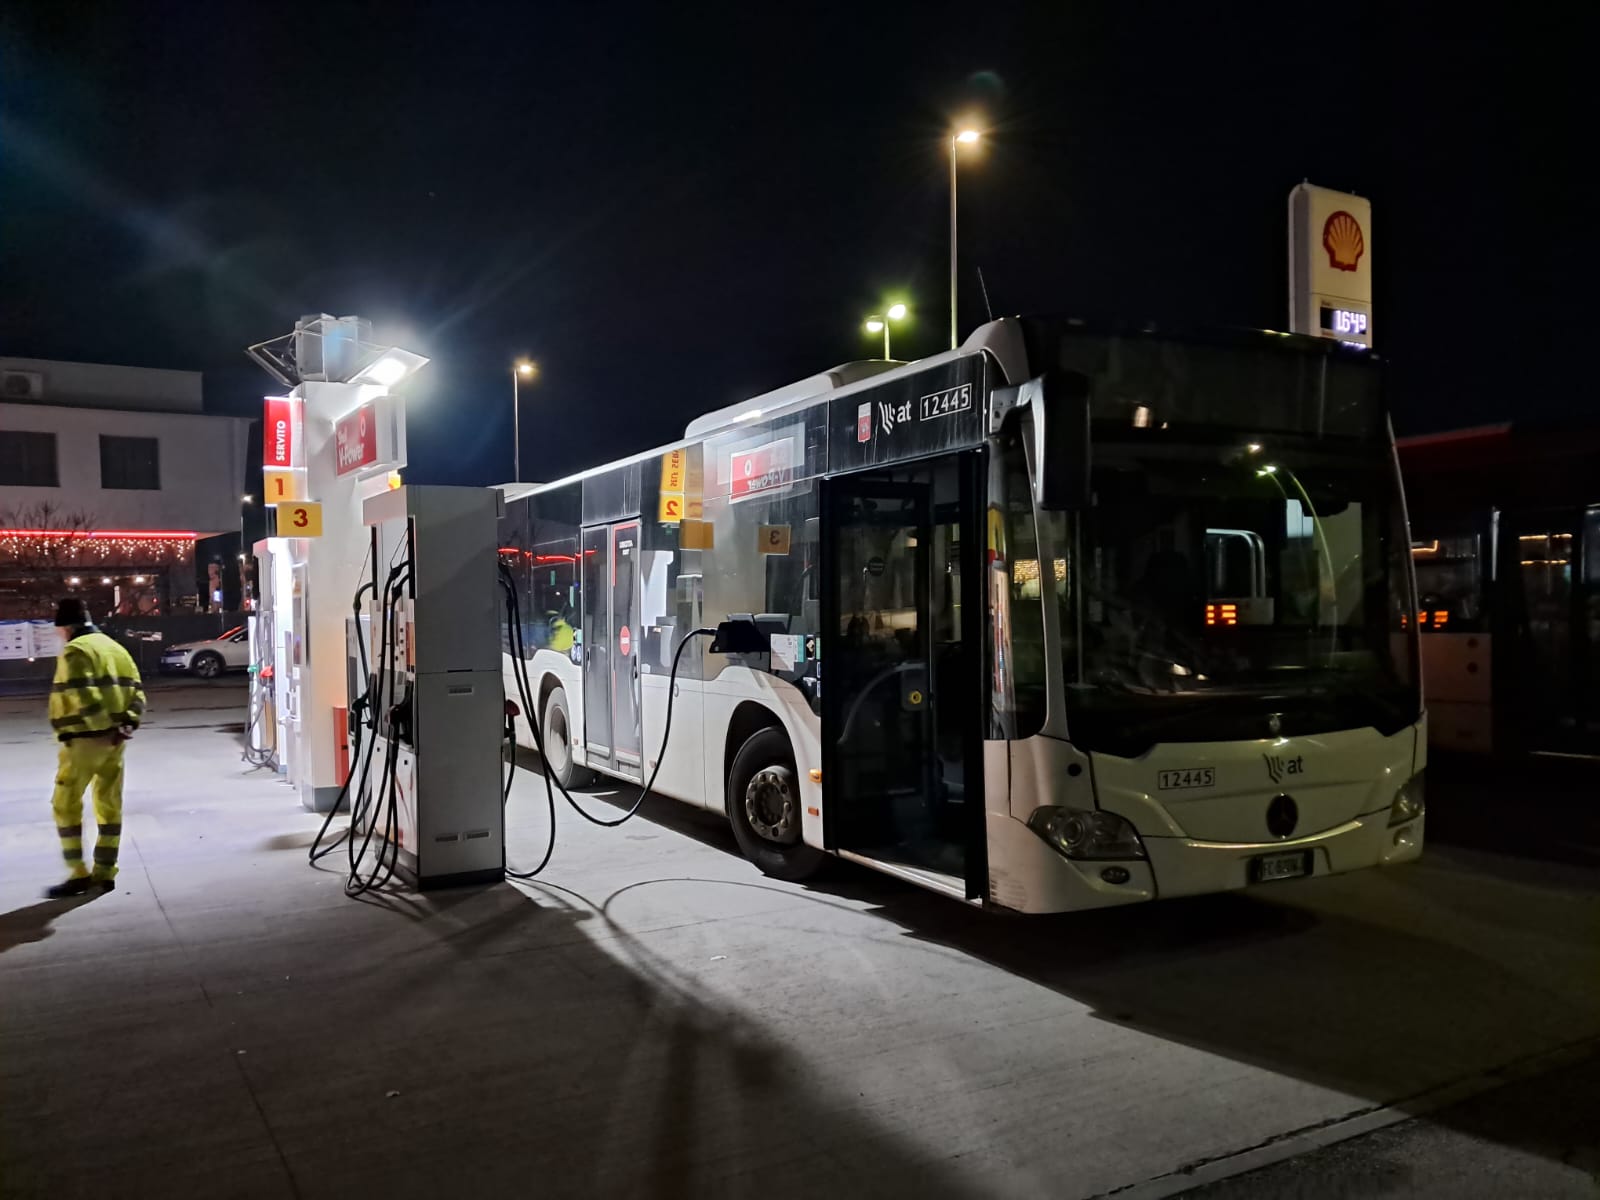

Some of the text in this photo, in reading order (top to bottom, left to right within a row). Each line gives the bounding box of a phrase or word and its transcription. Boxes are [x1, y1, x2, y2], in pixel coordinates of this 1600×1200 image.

[896, 400, 912, 423] at
[923, 387, 969, 417] 12445
[276, 420, 286, 461] SERVITO
[275, 478, 284, 496] 1
[293, 508, 308, 528] 3
[1287, 755, 1304, 774] at
[1162, 769, 1212, 788] 12445
